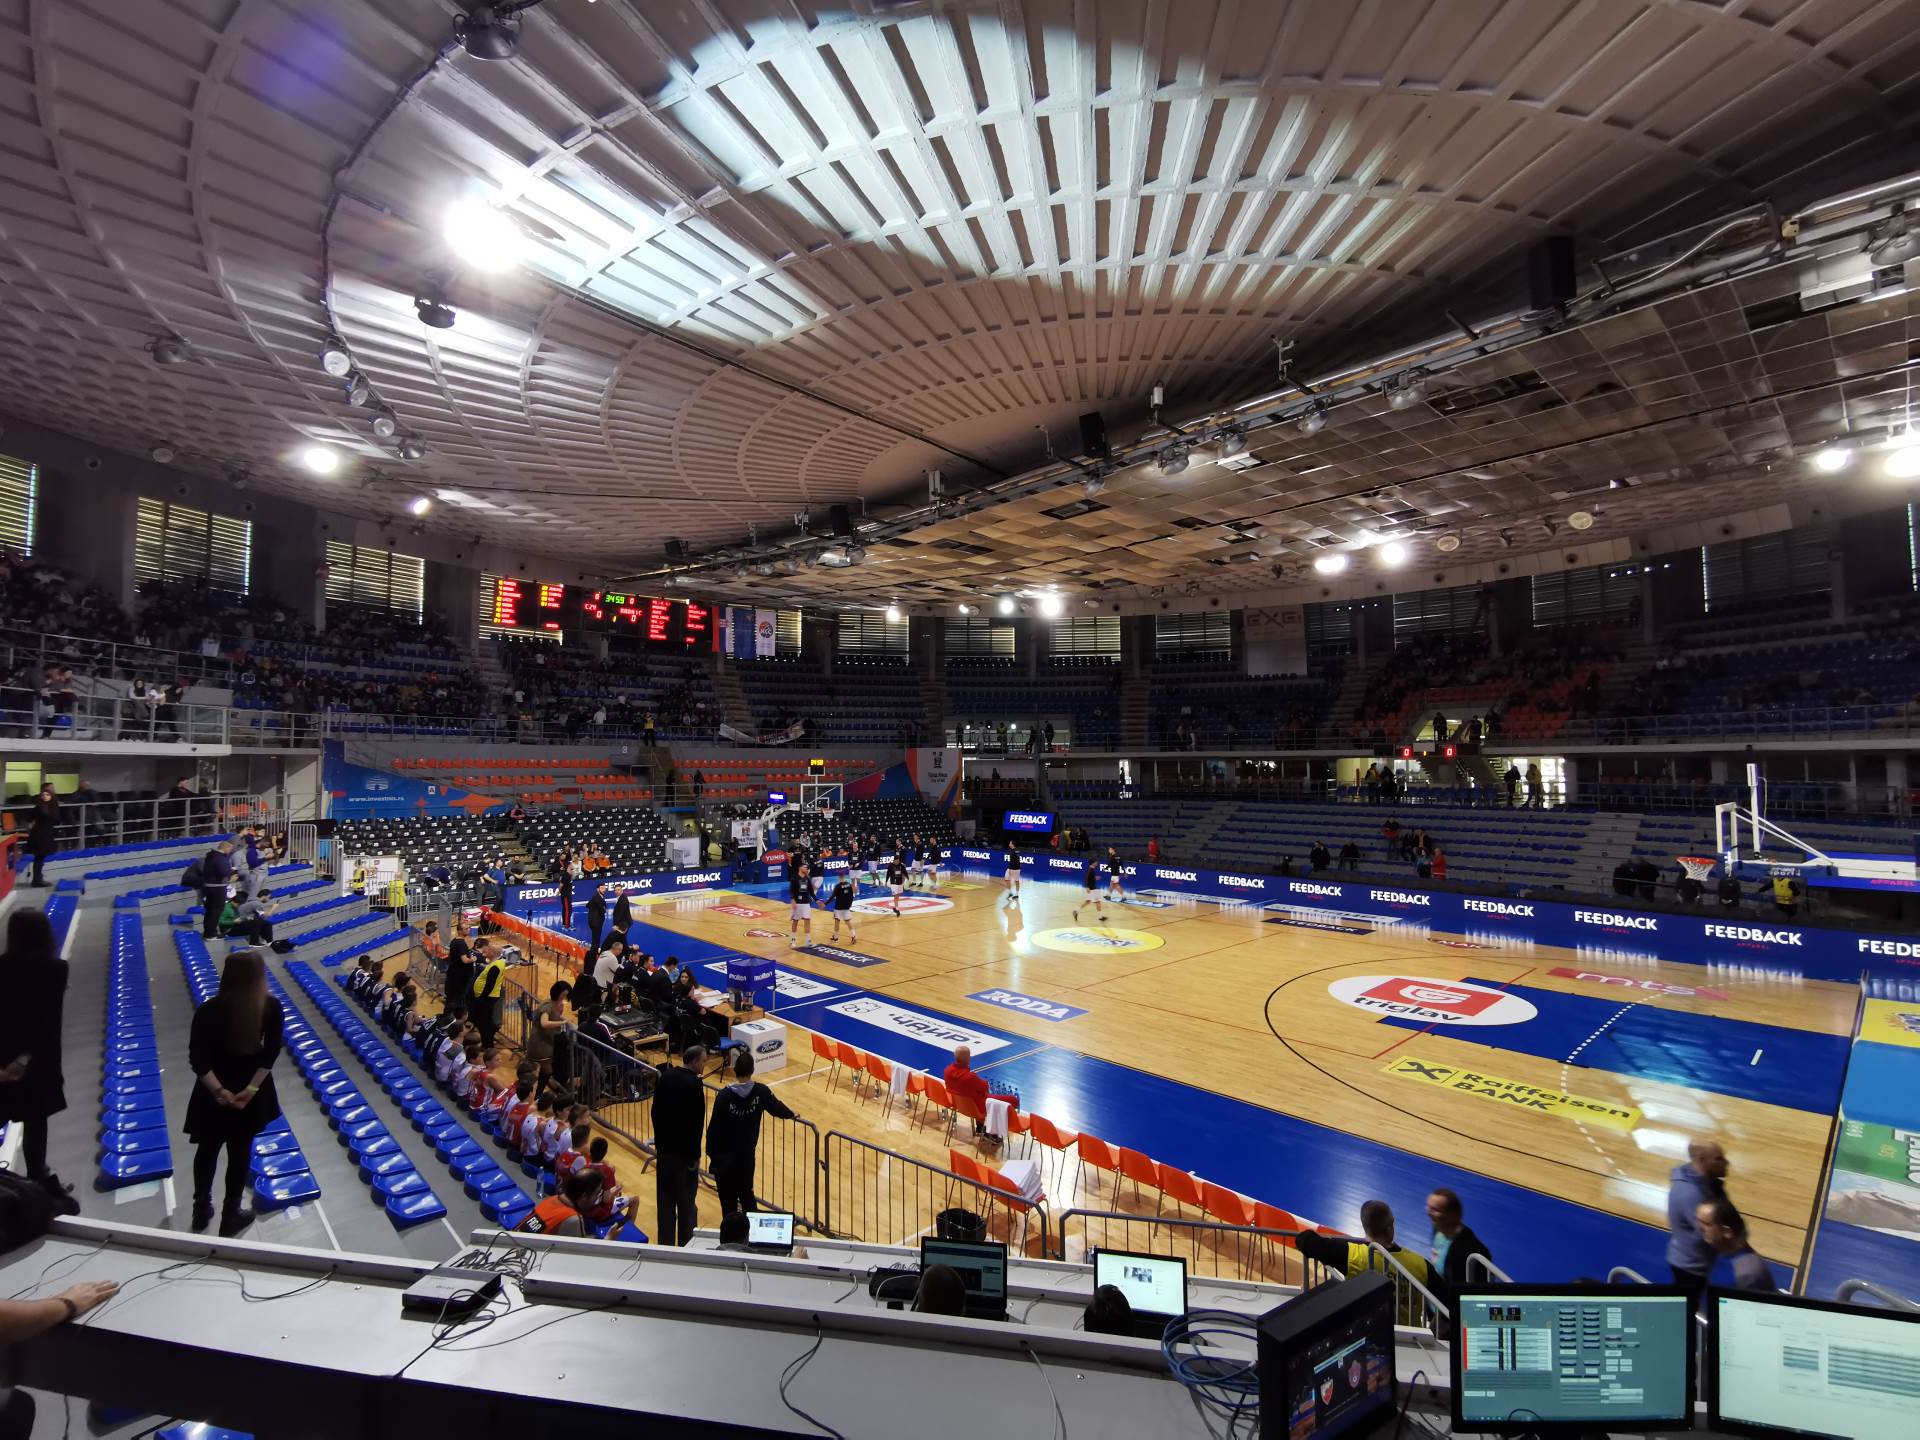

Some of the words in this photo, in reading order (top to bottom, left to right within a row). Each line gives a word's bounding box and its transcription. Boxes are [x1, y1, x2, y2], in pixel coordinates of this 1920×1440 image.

[1010, 814, 1047, 825] FEEDBACK
[963, 850, 991, 860] FEEDBACK
[1049, 858, 1083, 870] FEEDBACK
[676, 872, 721, 885] FEEDBACK
[1155, 869, 1198, 882] FEEDBACK
[1218, 875, 1265, 889] FEEDBACK
[1289, 882, 1342, 897] FEEDBACK
[1370, 890, 1431, 906] FEEDBACK
[1463, 899, 1535, 917] FEEDBACK
[1280, 919, 1358, 932] FEEDBACK
[1574, 910, 1658, 931] FEEDBACK
[1704, 924, 1803, 946] FEEDBACK
[1575, 972, 1697, 995] mts
[980, 990, 1070, 1020] RODA
[1352, 996, 1465, 1022] triglav
[1451, 1081, 1556, 1111] BANK
[1461, 1072, 1631, 1119] Raiffeisen
